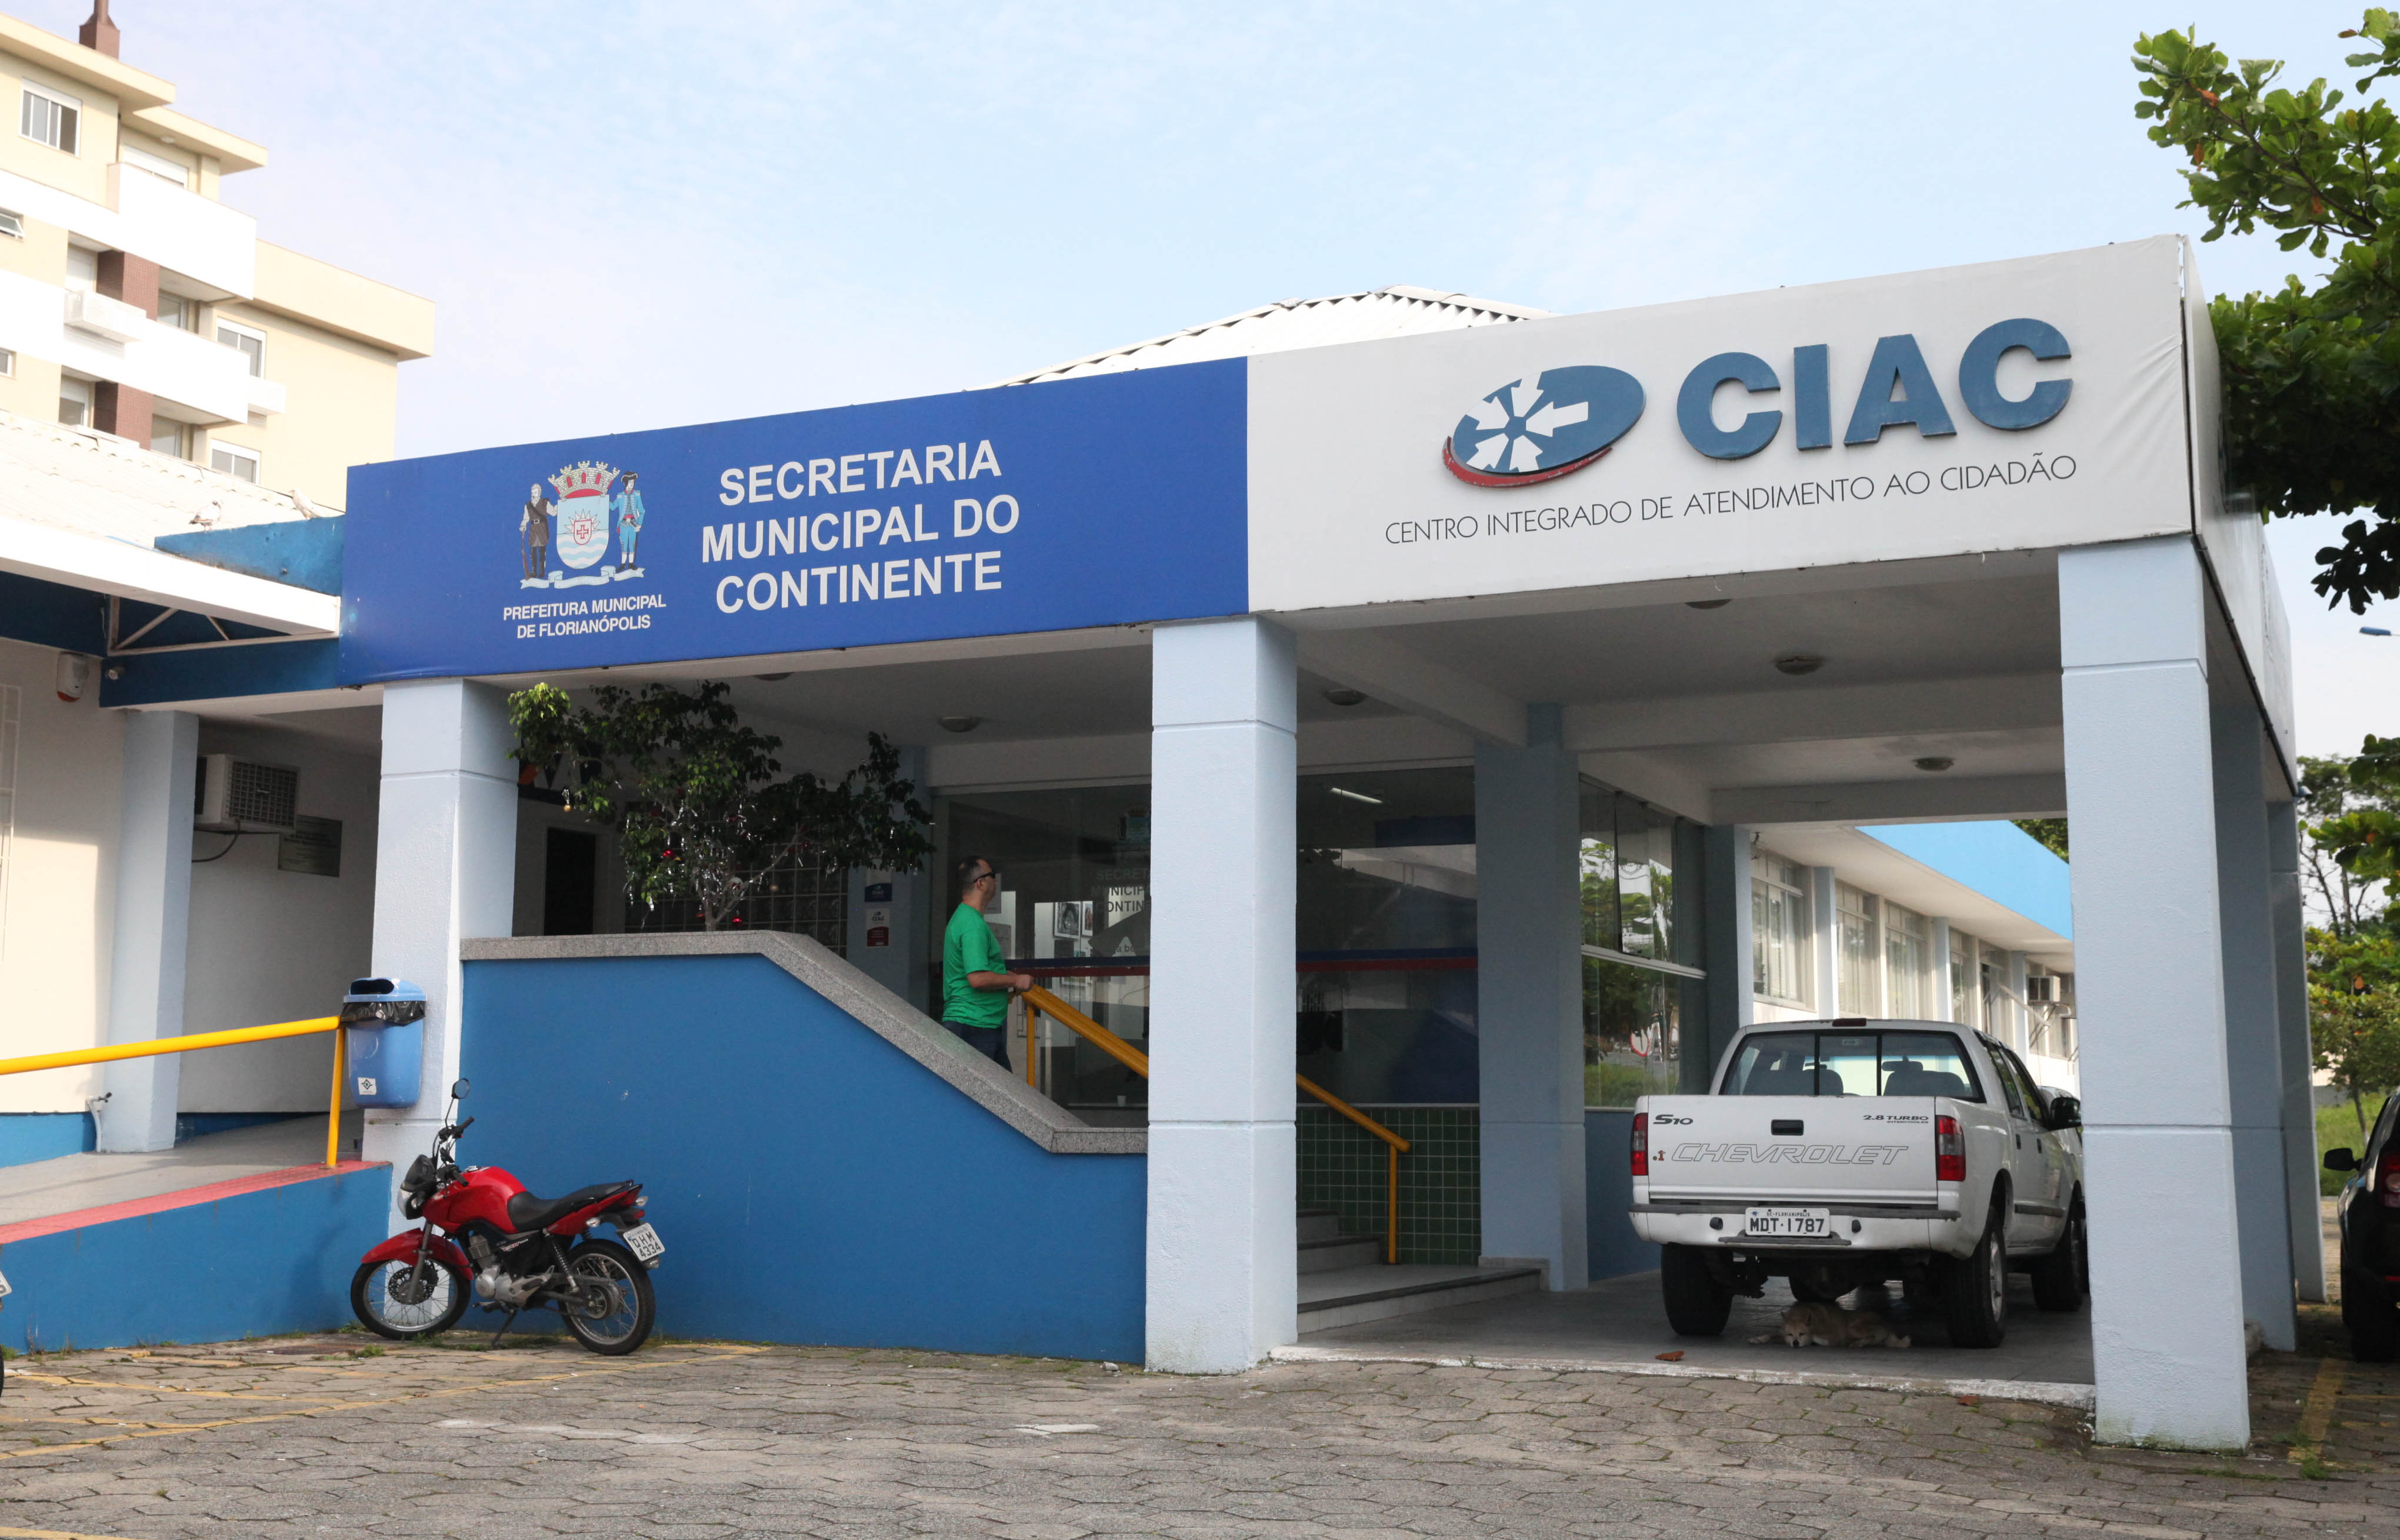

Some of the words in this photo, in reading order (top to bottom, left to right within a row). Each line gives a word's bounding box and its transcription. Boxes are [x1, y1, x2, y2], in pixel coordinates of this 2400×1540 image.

[1676, 318, 2072, 461] CIAC
[719, 439, 1002, 506] SECRETARIA
[1385, 516, 1478, 545] CENTRO
[1487, 501, 1632, 536] INTEGRADO
[1641, 496, 1674, 521] DE
[1684, 476, 1875, 516] ATENDIMENTO
[1883, 471, 1931, 498] AO
[1940, 451, 2077, 492] CIDADÃO
[702, 504, 939, 563] MUNICIPAL
[954, 494, 1019, 538] DO
[716, 550, 1002, 614] CONTINENTE
[503, 599, 589, 621] PREFEITURA
[592, 594, 667, 614] MUNICIPAL
[517, 624, 536, 639] DE
[539, 614, 651, 638] FLORIANÓPOLIS
[1653, 1114, 1694, 1125] S10
[1671, 1143, 1909, 1165] CHEVROLET
[632, 1231, 655, 1248] QHM
[639, 1242, 661, 1258] 4334
